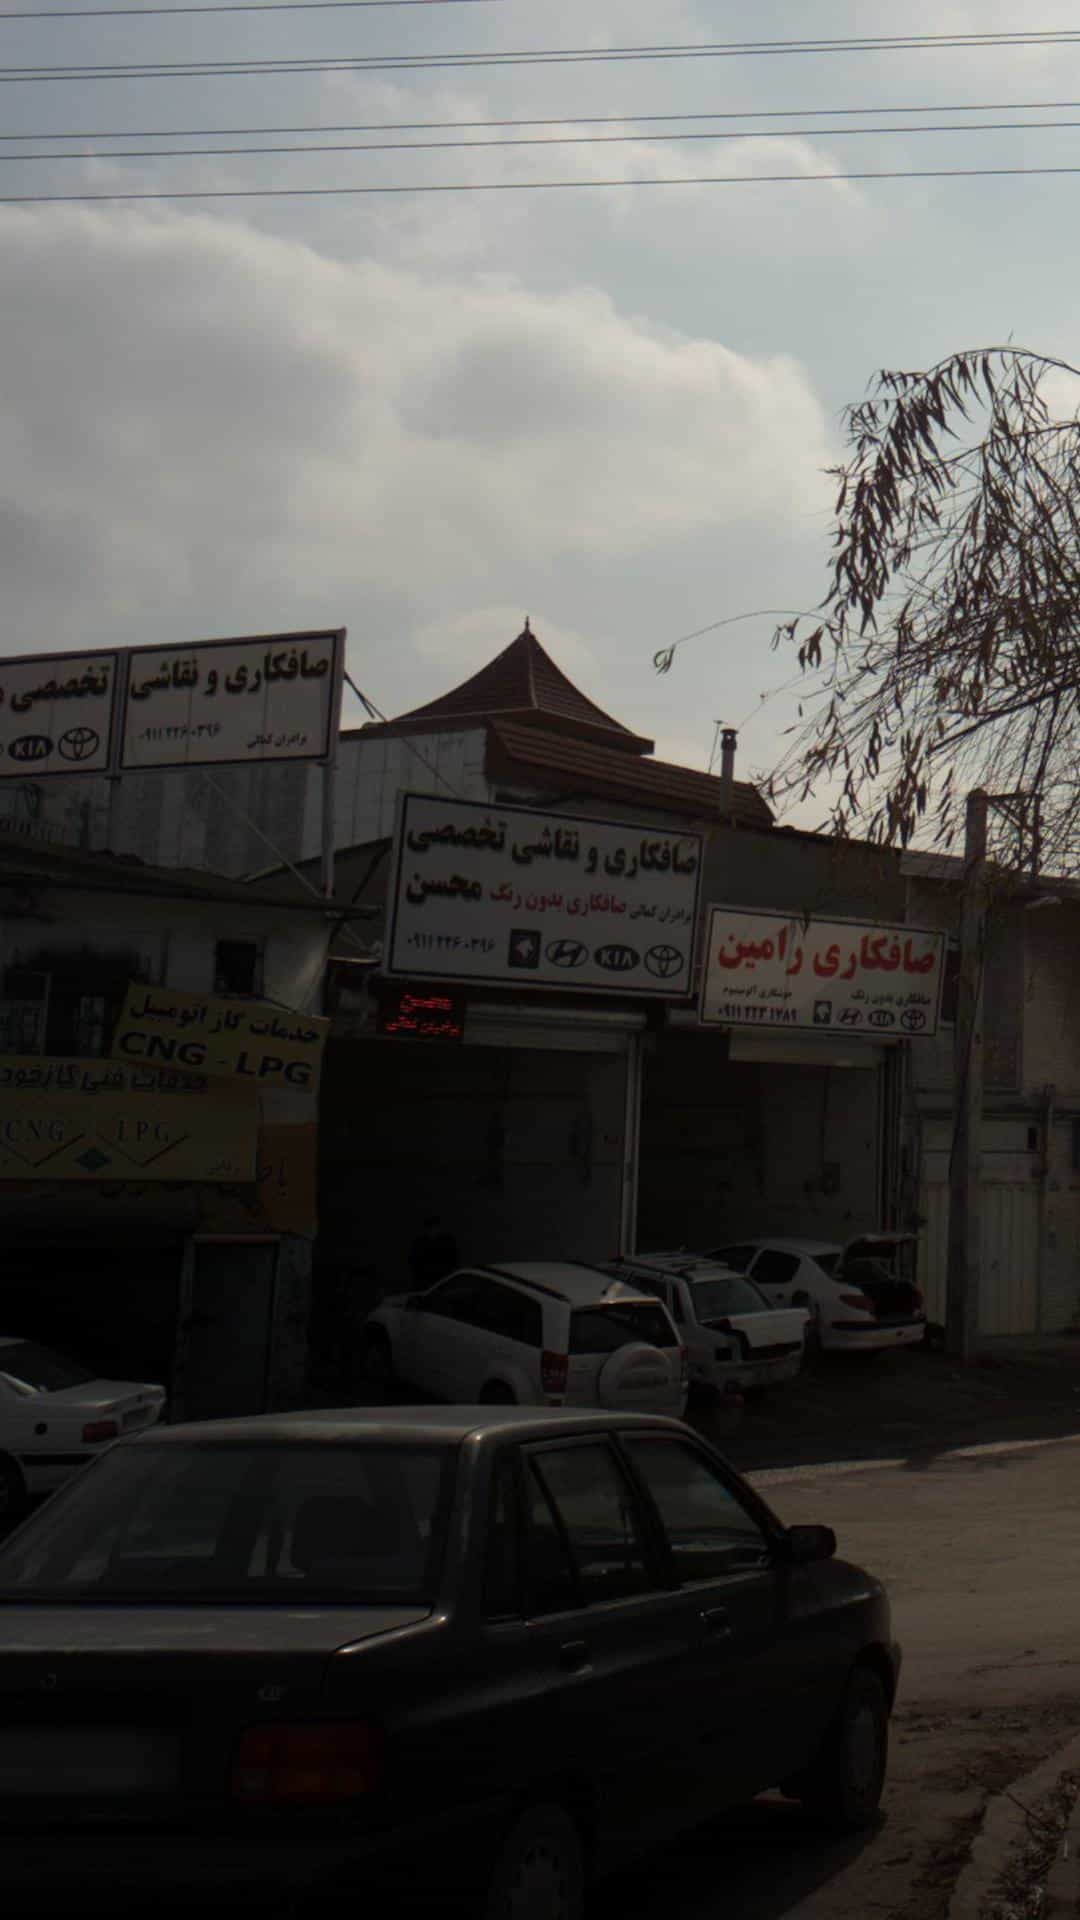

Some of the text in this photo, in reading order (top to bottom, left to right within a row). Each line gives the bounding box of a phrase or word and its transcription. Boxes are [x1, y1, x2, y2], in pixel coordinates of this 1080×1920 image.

[11, 664, 111, 712] تخصصی
[131, 646, 329, 700] صافکاری و نقاشی
[406, 818, 697, 877] صافکاری و نقاشی تخصصی
[406, 870, 482, 903] محسن
[489, 882, 627, 917] صافکاری بدون رنگ
[718, 925, 937, 981] صافکاری رامین
[130, 993, 320, 1044] خدمات گاز اتومبیل
[119, 1031, 207, 1066] CNG
[235, 1050, 313, 1086] LPG
[5, 1119, 170, 1143] CNG LPG
